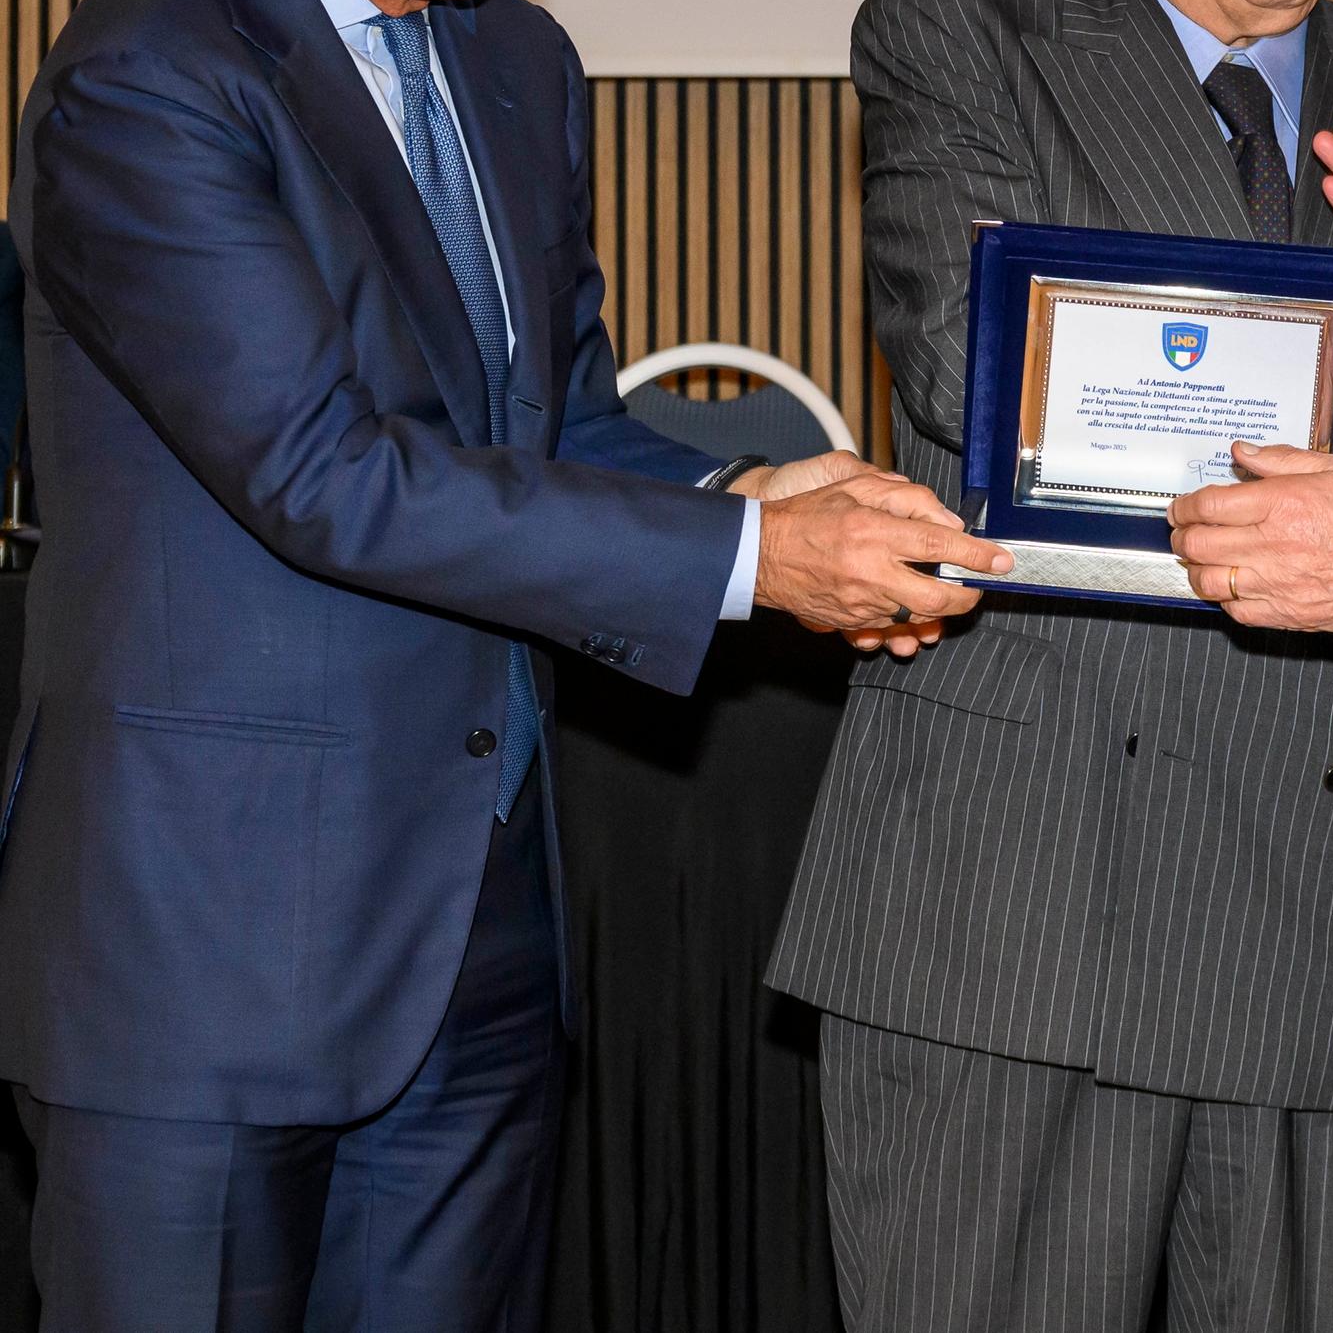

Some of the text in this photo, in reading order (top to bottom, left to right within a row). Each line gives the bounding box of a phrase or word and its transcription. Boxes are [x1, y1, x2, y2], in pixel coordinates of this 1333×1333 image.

[1171, 334, 1198, 348] LND
[1082, 384, 1090, 392] la
[1092, 385, 1110, 395] Lega
[1112, 387, 1152, 397] Nazionale
[1153, 390, 1190, 400] Dilettanti
[1206, 395, 1227, 404] stima
[1234, 398, 1277, 408] gratitudine
[1137, 378, 1225, 392] Ad Antonio Papponetti
[1081, 397, 1095, 405] per
[1096, 397, 1103, 405] la
[1104, 399, 1140, 408] passione,
[1141, 401, 1149, 409] la
[1150, 403, 1195, 412] competenza
[1202, 405, 1210, 413] lo
[1211, 407, 1236, 416] spirito
[1247, 410, 1277, 419] servizio
[1088, 419, 1103, 427] alla
[1104, 422, 1133, 430] crescita
[1134, 423, 1146, 431] del
[1148, 424, 1170, 433] calcio
[1171, 426, 1223, 438] dilettantistico
[1229, 431, 1266, 441] giovanile.
[1104, 409, 1114, 417] ha
[1116, 411, 1142, 420] saputo
[1143, 413, 1187, 424] contribuire,
[1189, 416, 1208, 425] nella
[1224, 419, 1246, 429] lunga
[1247, 423, 1280, 432] carriera,
